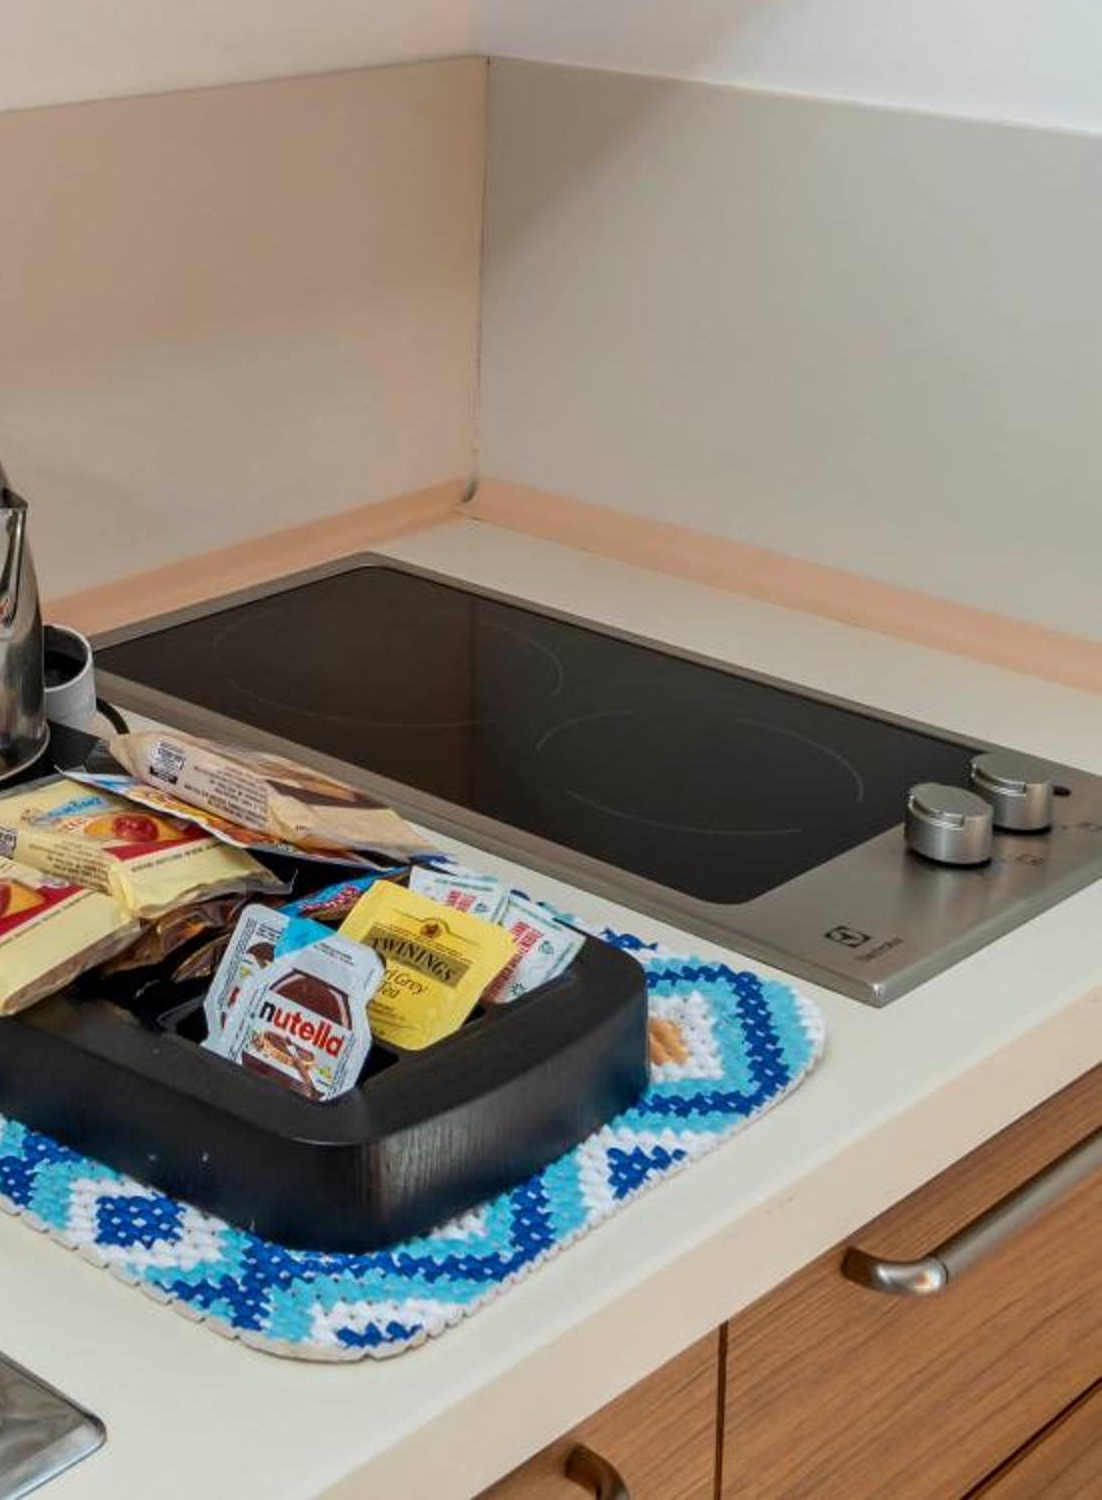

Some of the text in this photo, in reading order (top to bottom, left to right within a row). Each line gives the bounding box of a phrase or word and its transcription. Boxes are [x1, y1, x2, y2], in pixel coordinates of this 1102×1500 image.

[368, 937, 453, 982] TWININGS
[394, 971, 429, 996] Grey
[259, 1000, 346, 1058] nutella
